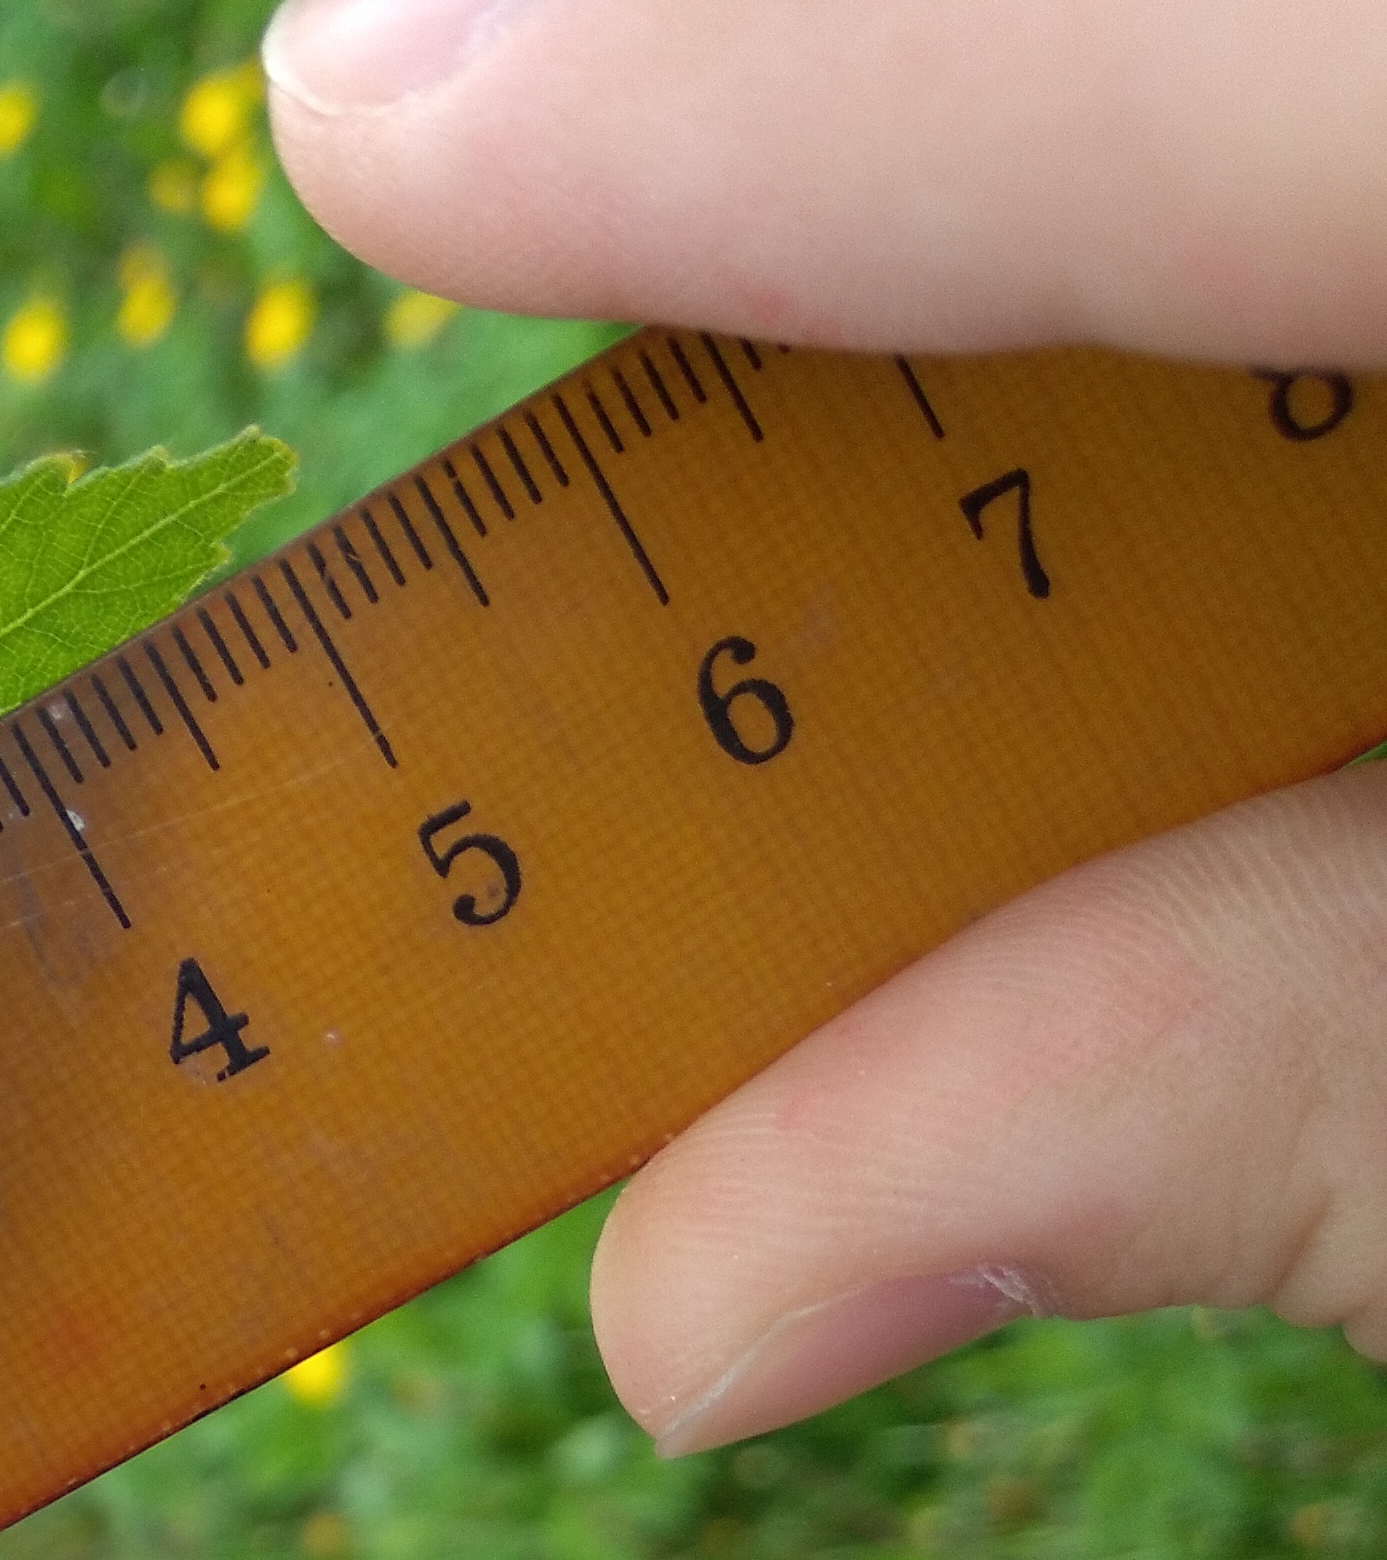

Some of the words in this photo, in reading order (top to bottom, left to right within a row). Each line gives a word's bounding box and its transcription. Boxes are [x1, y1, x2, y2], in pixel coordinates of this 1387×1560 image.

[170, 958, 269, 1081] 4
[418, 801, 521, 925] 5
[698, 636, 793, 764] 6
[960, 468, 1050, 599] 7
